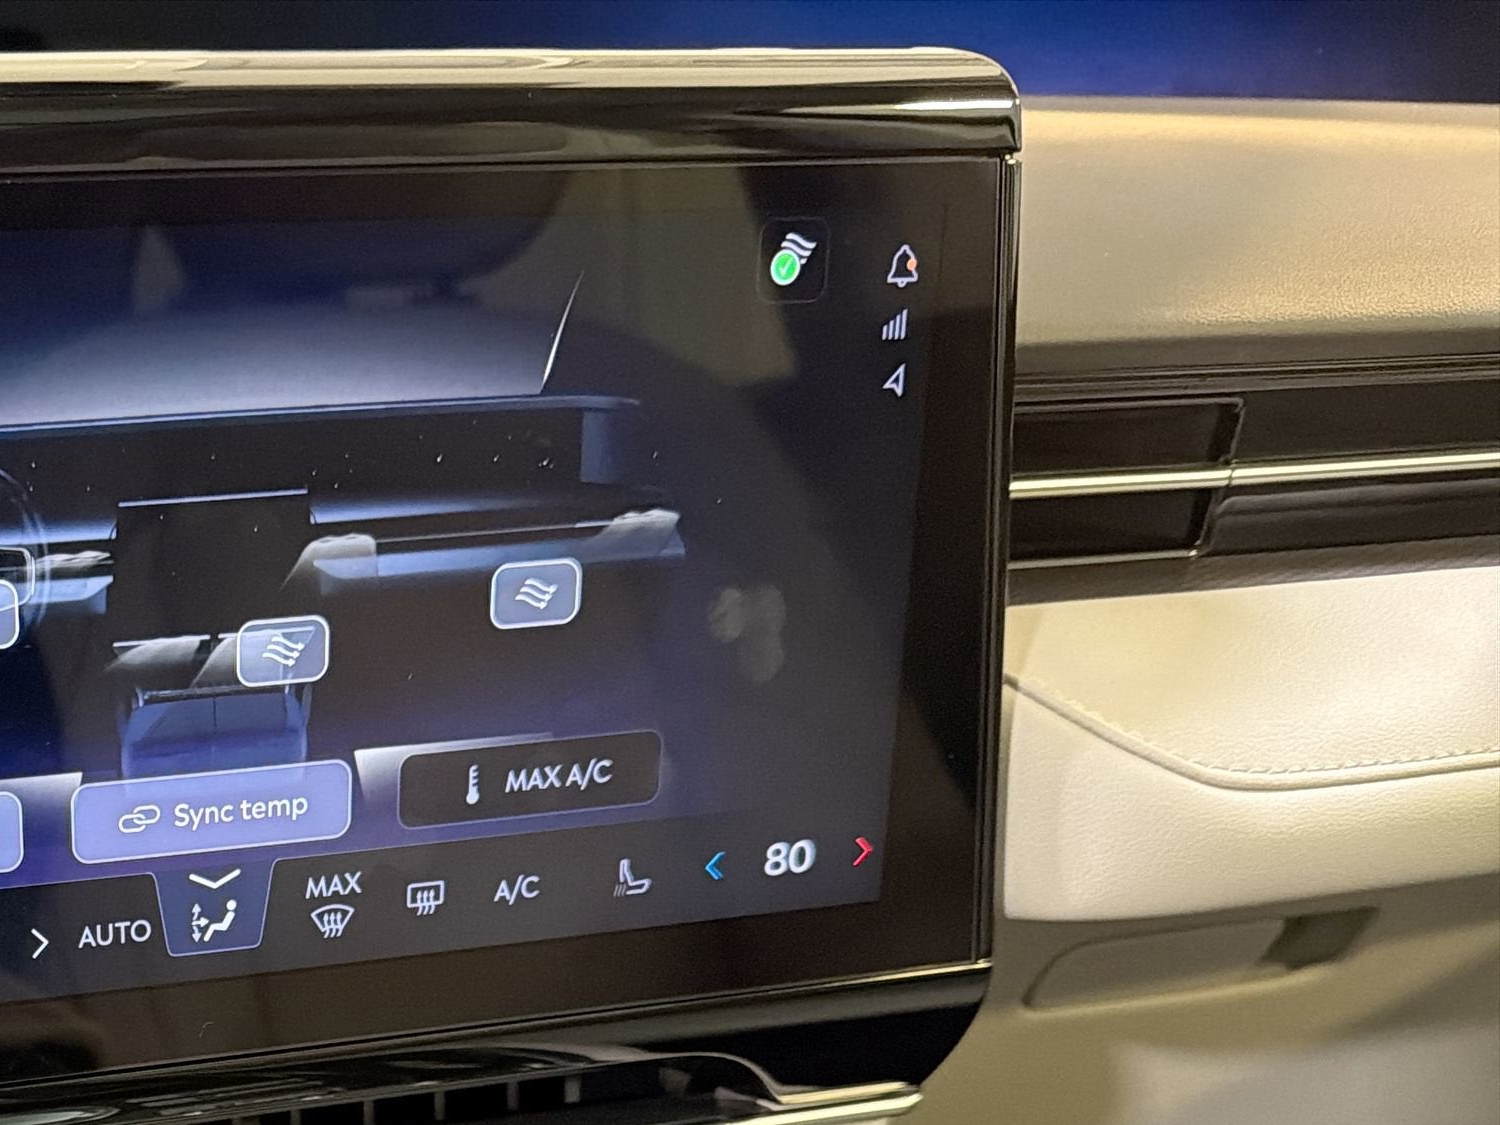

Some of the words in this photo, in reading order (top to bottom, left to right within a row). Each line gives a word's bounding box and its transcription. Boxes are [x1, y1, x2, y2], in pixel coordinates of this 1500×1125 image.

[505, 764, 562, 793] MAX
[565, 758, 613, 791] A/C
[174, 803, 234, 831] Sync
[240, 797, 308, 820] temp
[764, 839, 817, 877] 80
[305, 871, 362, 899] MAX
[494, 874, 540, 906] A/C
[78, 919, 151, 948] AUTO
